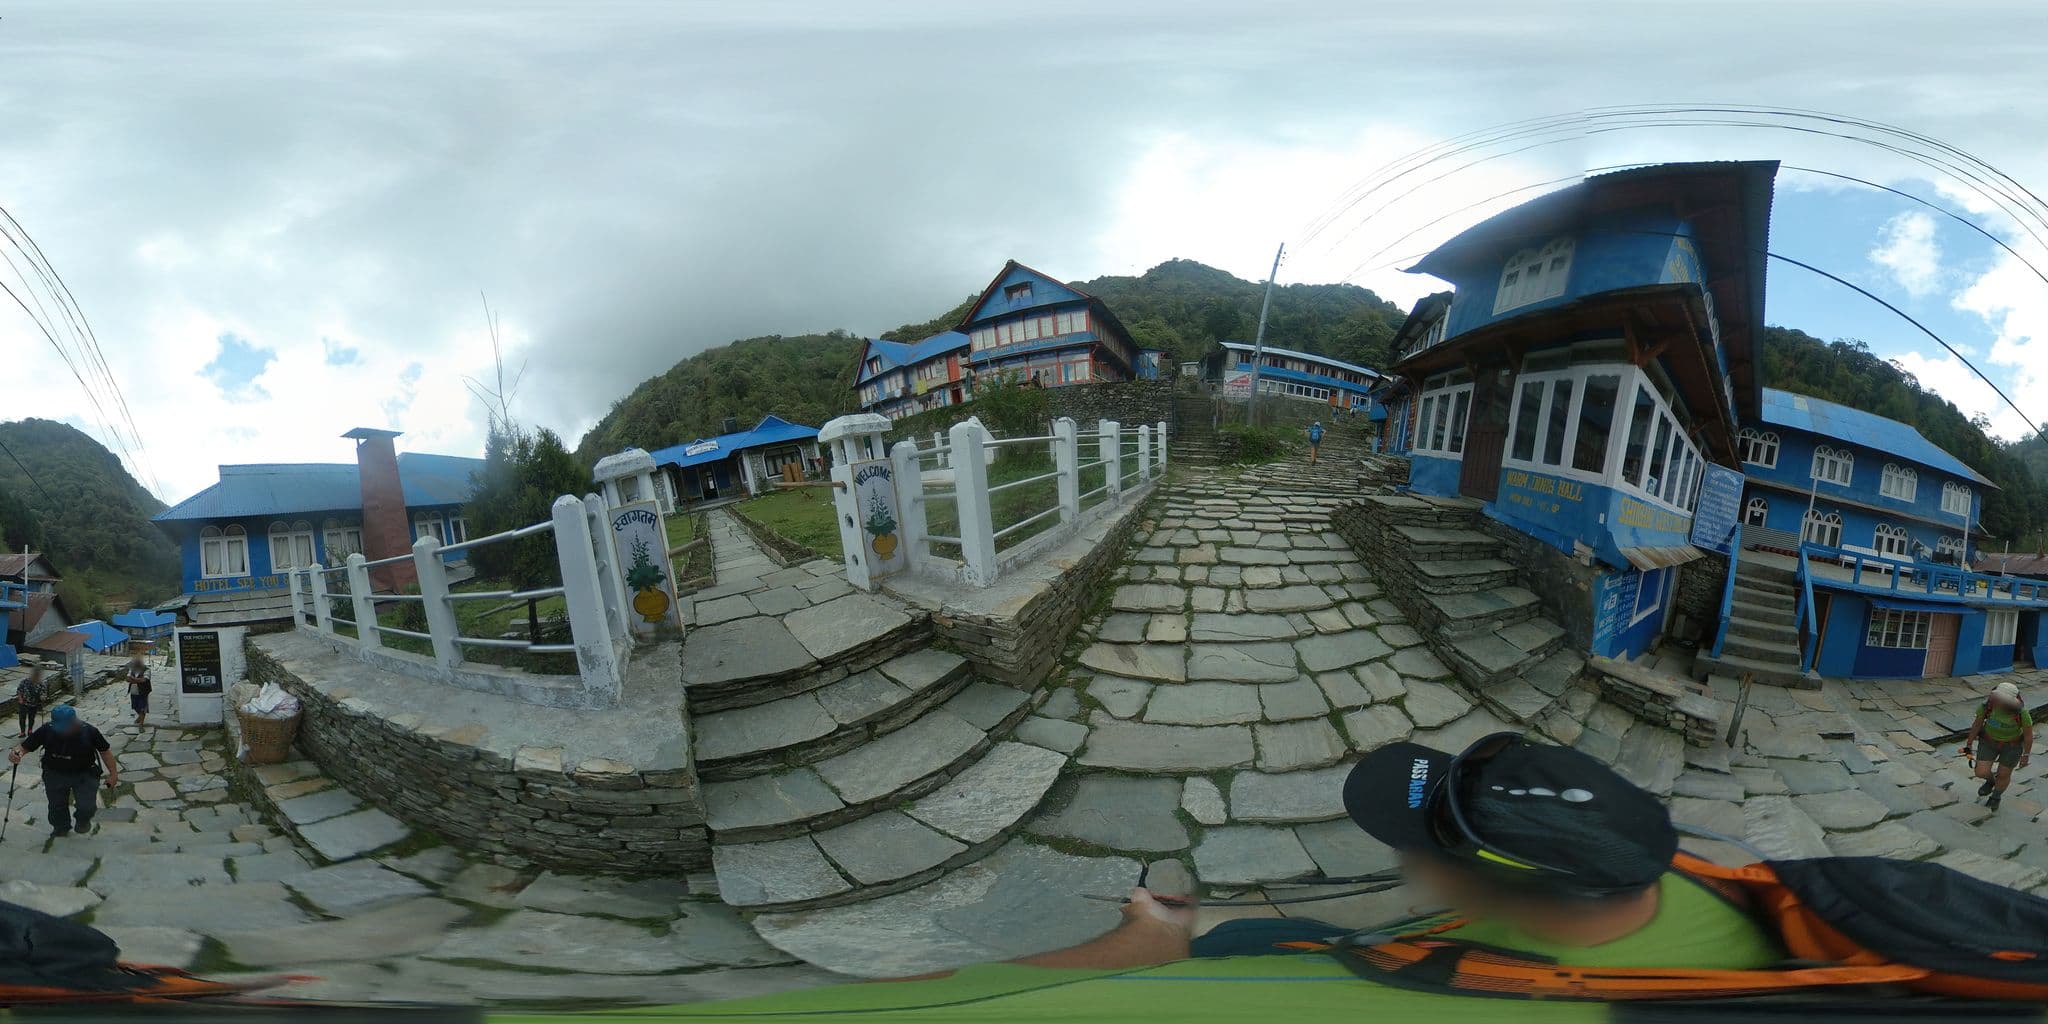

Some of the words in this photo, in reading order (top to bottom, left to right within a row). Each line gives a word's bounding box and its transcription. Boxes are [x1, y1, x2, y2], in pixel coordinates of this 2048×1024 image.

[855, 465, 892, 487] WELCOME
[1558, 479, 1584, 502] HALL
[194, 579, 232, 592] HOTEL
